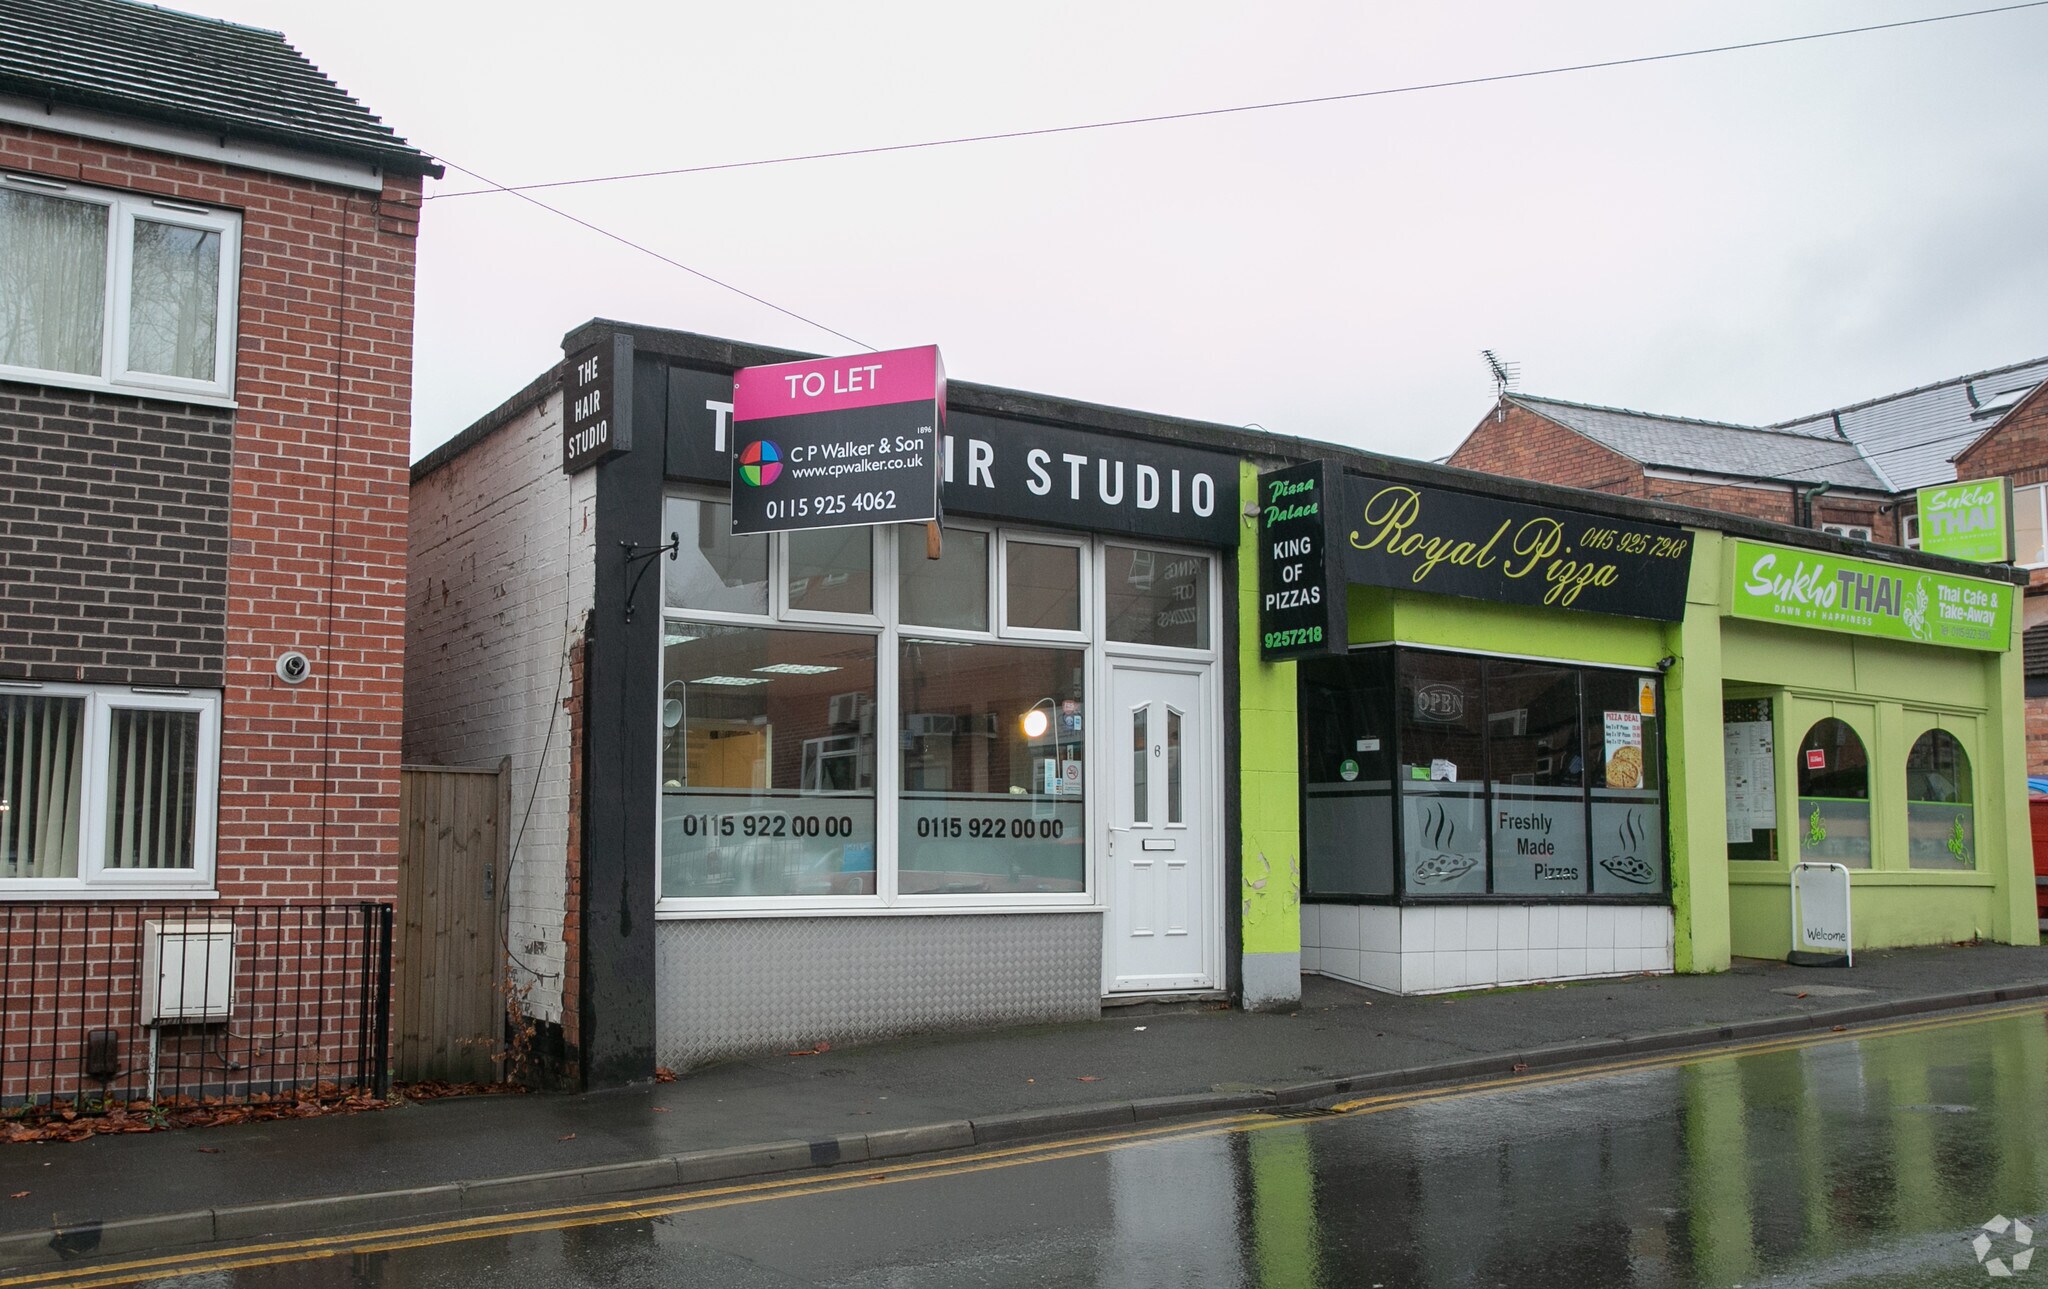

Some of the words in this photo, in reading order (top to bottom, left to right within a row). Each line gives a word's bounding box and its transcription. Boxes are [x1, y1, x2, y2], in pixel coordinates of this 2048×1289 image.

[578, 355, 598, 387] THE
[784, 372, 826, 399] TO
[834, 364, 883, 394] LET
[575, 389, 600, 423] HAIR
[568, 420, 607, 459] STUDIO
[917, 426, 932, 434] 1896
[791, 447, 804, 462] C
[808, 445, 818, 461] P
[821, 442, 874, 459] Walker
[878, 437, 891, 453] &
[895, 436, 924, 452] Son
[792, 453, 923, 478] www.cpwalker.co.uk
[944, 435, 995, 489] IR
[1026, 448, 1215, 518] STUDIO
[1269, 479, 1314, 503] Pizza
[1927, 486, 1994, 511] Sukho
[766, 498, 808, 519] 0115
[814, 495, 846, 515] 925
[852, 490, 897, 511] 4062
[1264, 502, 1319, 528] Palace
[1927, 506, 1995, 536] THAI
[1273, 536, 1311, 560] KING
[1350, 486, 1511, 583] Royal
[1503, 517, 1619, 607] Pizza
[1580, 527, 1619, 550] 0115
[1616, 532, 1651, 554] 925
[1649, 536, 1687, 559] 7218
[1282, 563, 1303, 583] OF
[1266, 586, 1320, 611] PIZZAS
[1937, 584, 1960, 602] Thai
[1963, 588, 1988, 607] Cafe
[1991, 592, 1998, 608] &
[1774, 604, 1800, 617] DAWN
[1822, 611, 1873, 626] HAPPINESS
[1939, 602, 1995, 627] Take-Away
[1264, 626, 1323, 648] 9257218
[1418, 692, 1463, 713] OPEN
[1606, 713, 1622, 721] PIZZA
[1624, 714, 1639, 722] DEAL
[1154, 744, 1161, 758] 6
[683, 814, 735, 837] 0115
[742, 815, 786, 837] 922
[792, 815, 820, 837] 00
[825, 816, 852, 838] 00
[917, 816, 962, 838] 0115
[968, 816, 1006, 838] 922
[1011, 817, 1036, 839] 00
[1039, 818, 1064, 840] 00
[1499, 812, 1552, 835] Freshly
[1517, 837, 1555, 855] Made
[1534, 863, 1579, 881] Pizzas
[1806, 927, 1846, 942] Welcome
